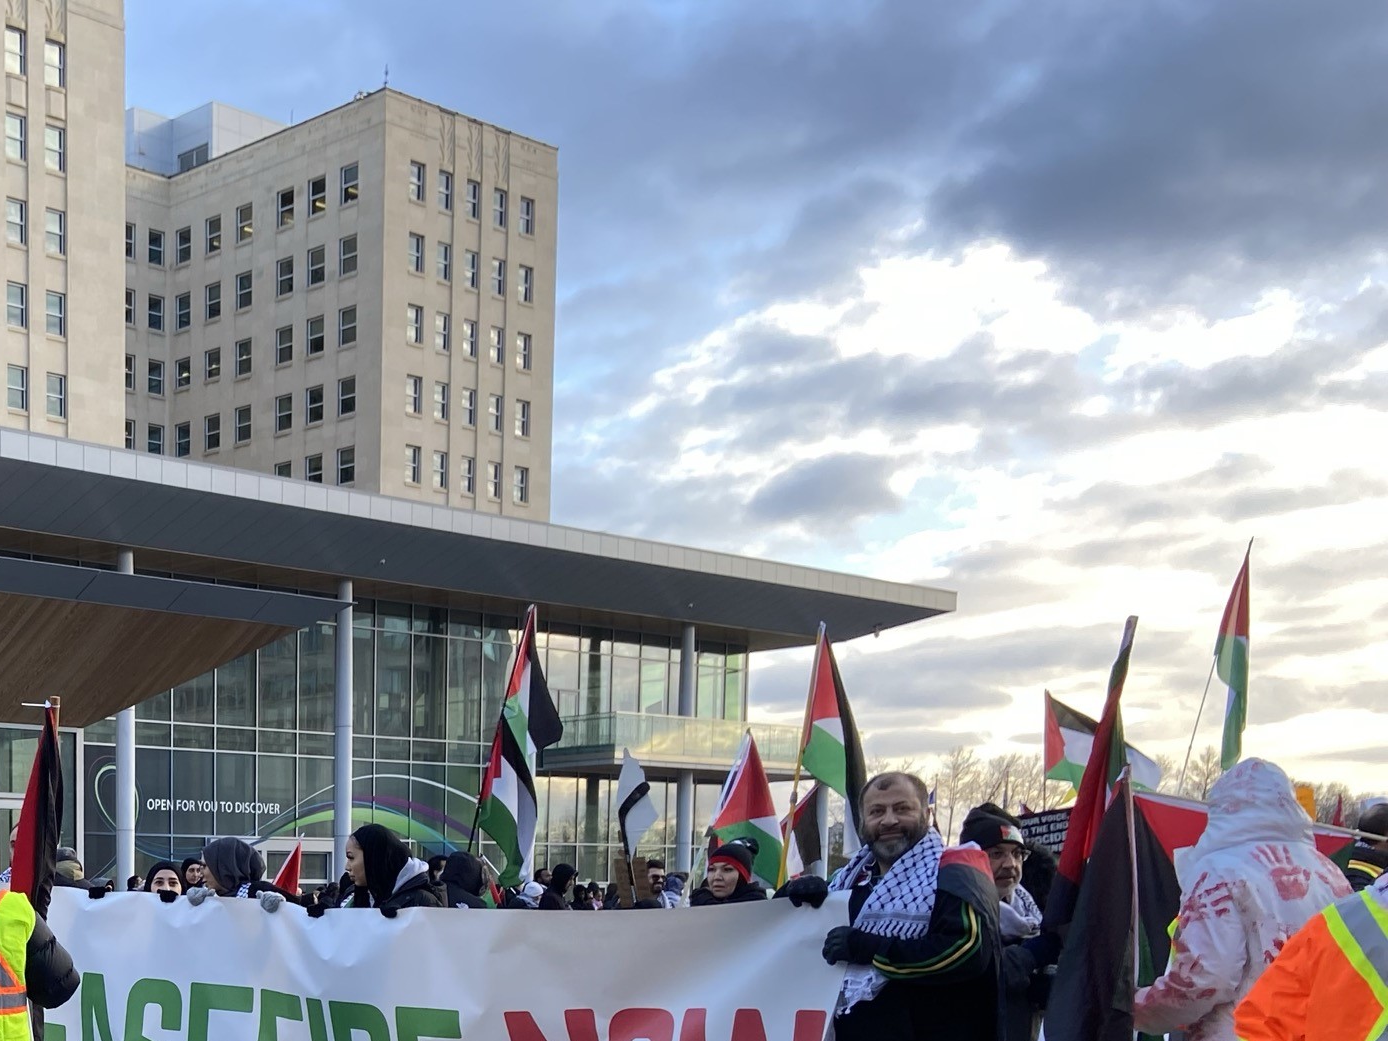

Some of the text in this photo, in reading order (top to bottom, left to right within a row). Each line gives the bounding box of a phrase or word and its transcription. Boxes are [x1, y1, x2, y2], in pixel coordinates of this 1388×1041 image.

[147, 799, 280, 814] OPEN FOR YOU TO DISCOVER
[1031, 825, 1049, 834] THE
[1050, 821, 1068, 831] END
